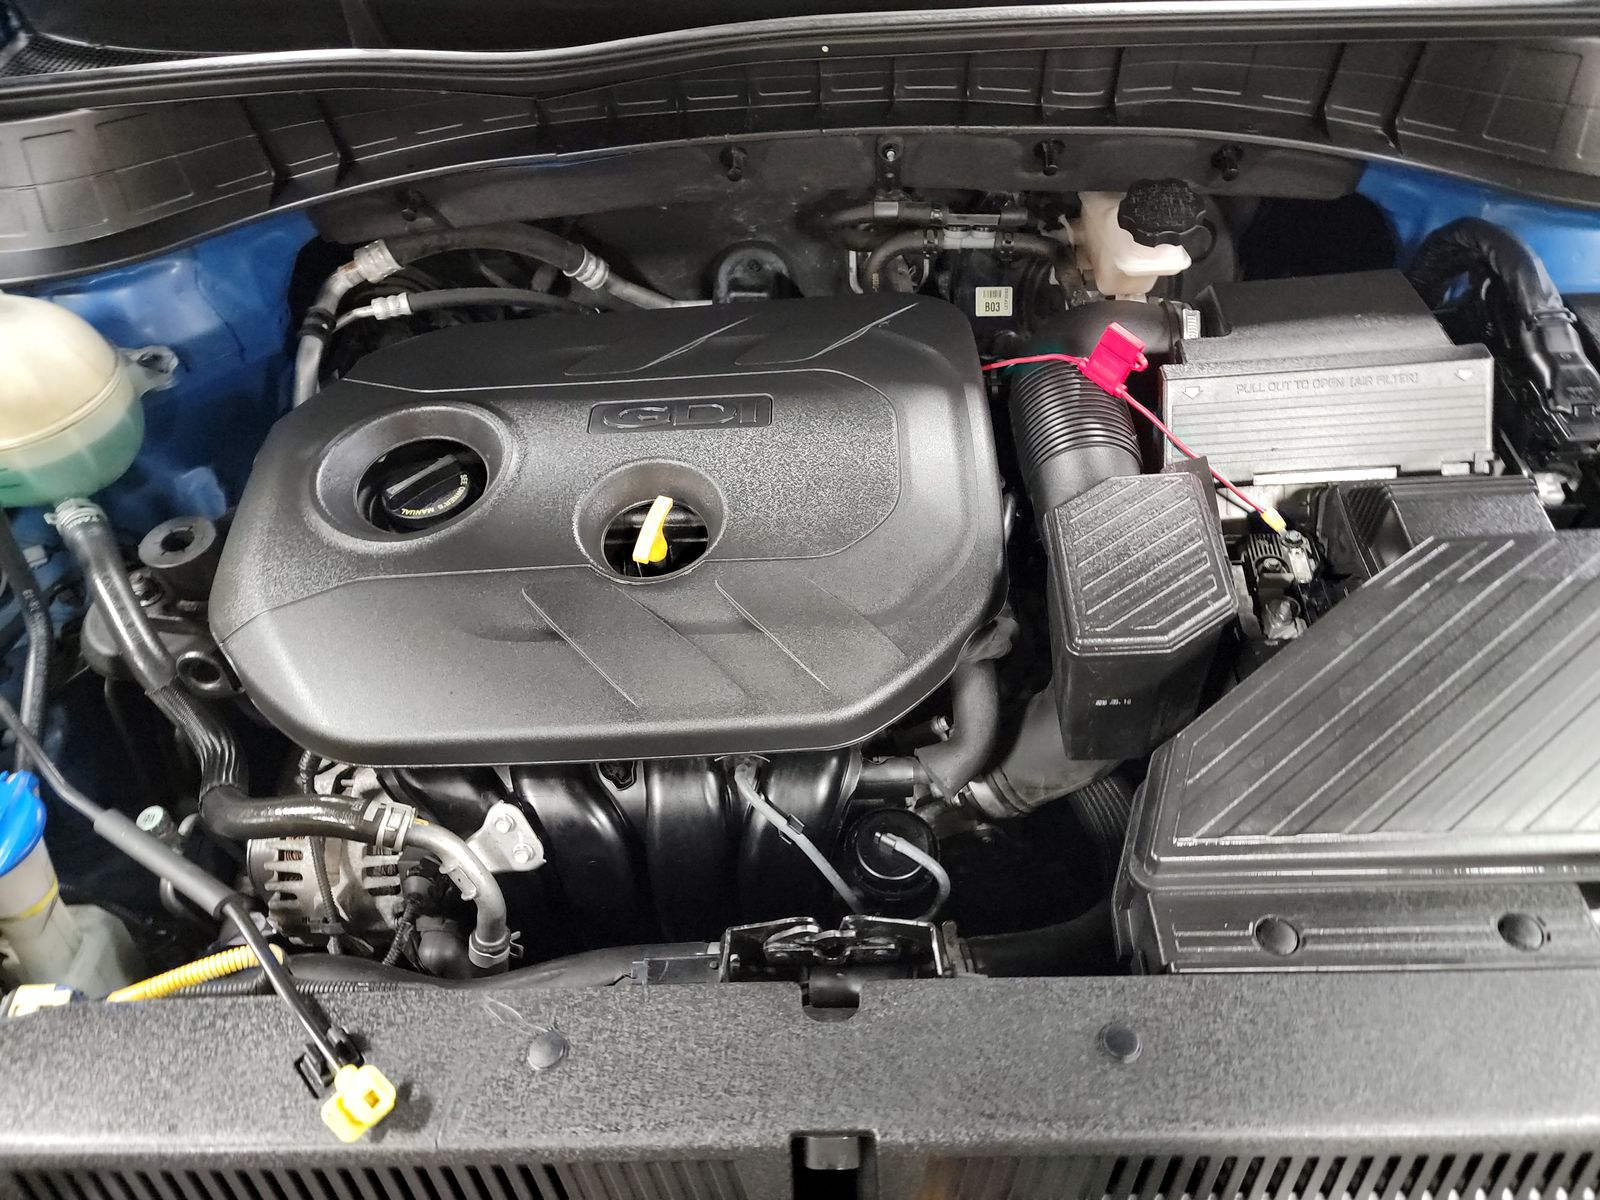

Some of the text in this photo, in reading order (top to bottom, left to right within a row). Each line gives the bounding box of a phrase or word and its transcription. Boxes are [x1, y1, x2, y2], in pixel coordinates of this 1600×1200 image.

[984, 301, 1001, 312] B03
[1236, 383, 1266, 395] PULL
[1268, 380, 1292, 392] OUT
[1294, 379, 1309, 390] TO
[1312, 376, 1345, 389] OPEN
[603, 401, 758, 430] GDI
[460, 474, 468, 486] SEE
[401, 507, 435, 515] MANUAL
